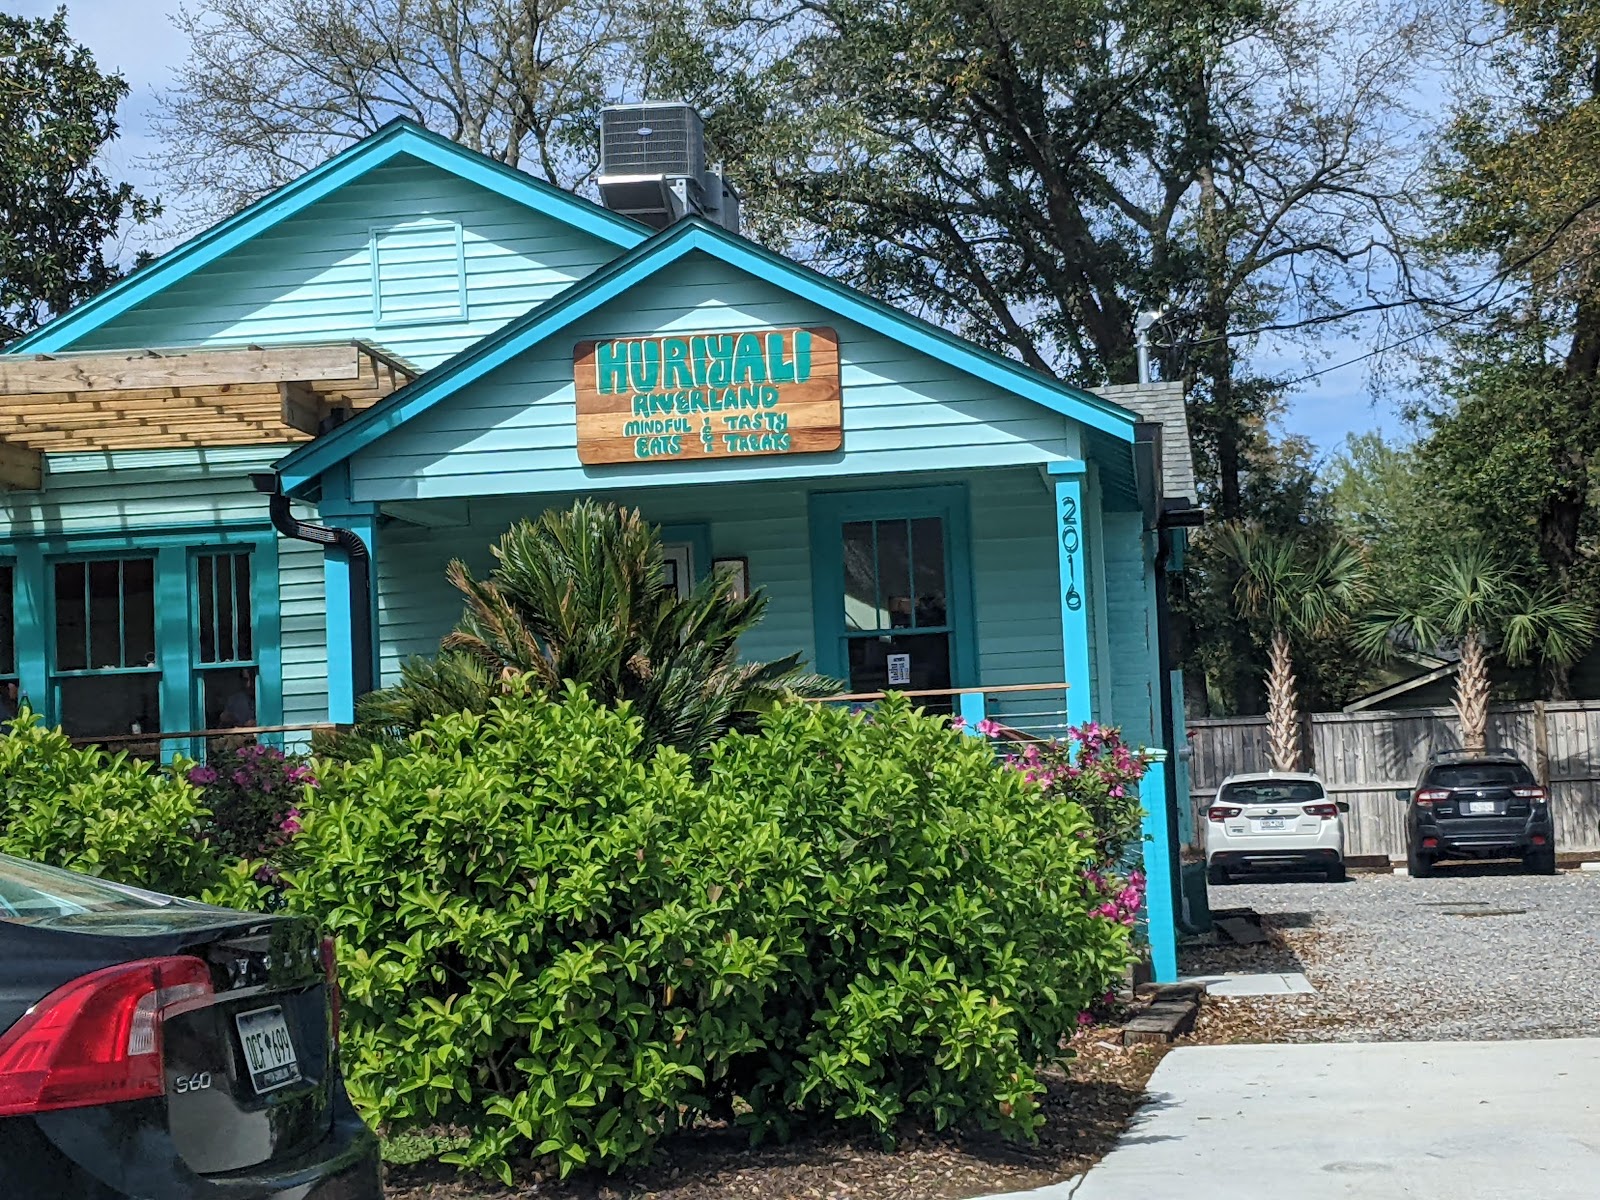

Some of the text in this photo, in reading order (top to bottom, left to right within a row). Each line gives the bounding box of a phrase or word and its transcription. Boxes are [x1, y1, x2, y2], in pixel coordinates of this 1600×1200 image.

[594, 331, 812, 395] HURIYALI
[631, 385, 780, 417] RIVERLAND
[623, 417, 692, 437] MINDFUL
[722, 412, 788, 433] TASTY
[634, 432, 792, 458] EATS TREATS
[1061, 496, 1082, 611] 2016
[271, 1027, 291, 1064] 699
[175, 1070, 212, 1094] S60
